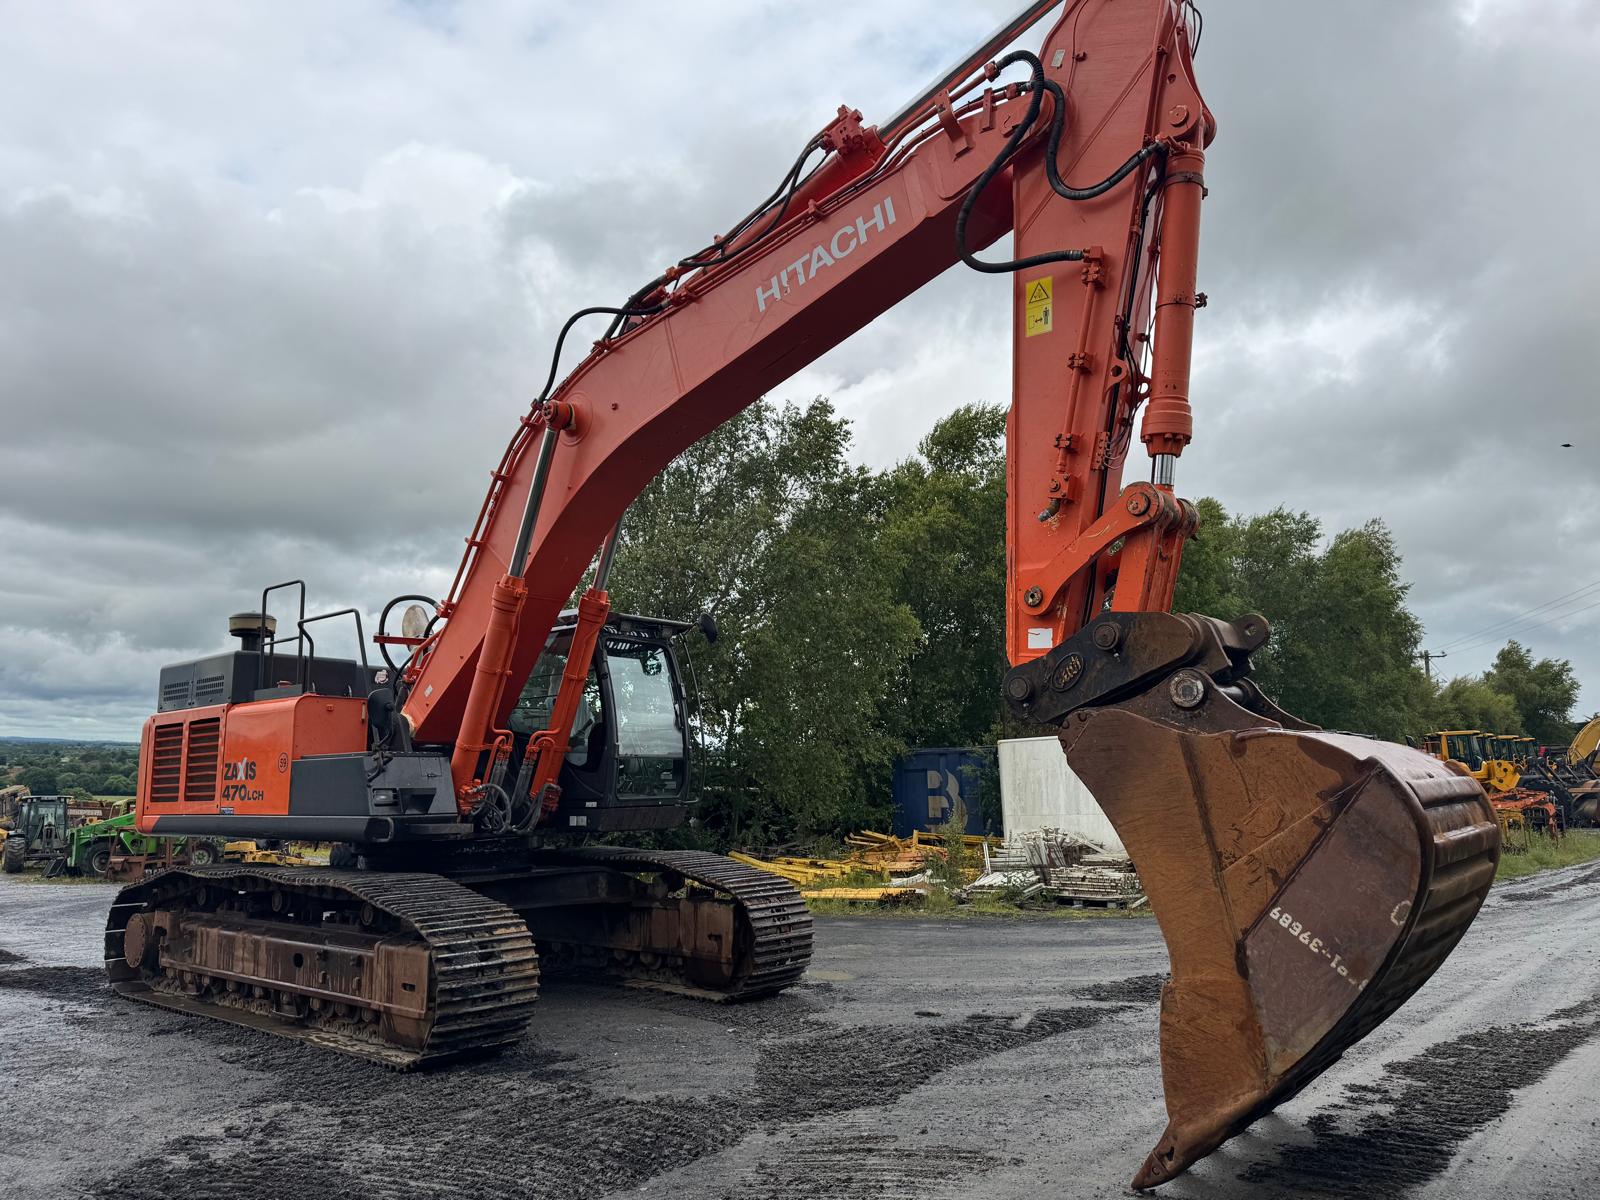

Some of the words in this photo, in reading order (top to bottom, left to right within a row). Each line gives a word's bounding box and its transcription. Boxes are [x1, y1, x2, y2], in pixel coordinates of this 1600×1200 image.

[755, 196, 897, 313] HITACHI
[224, 756, 257, 780] ZAXIS
[222, 784, 264, 801] 470LCH
